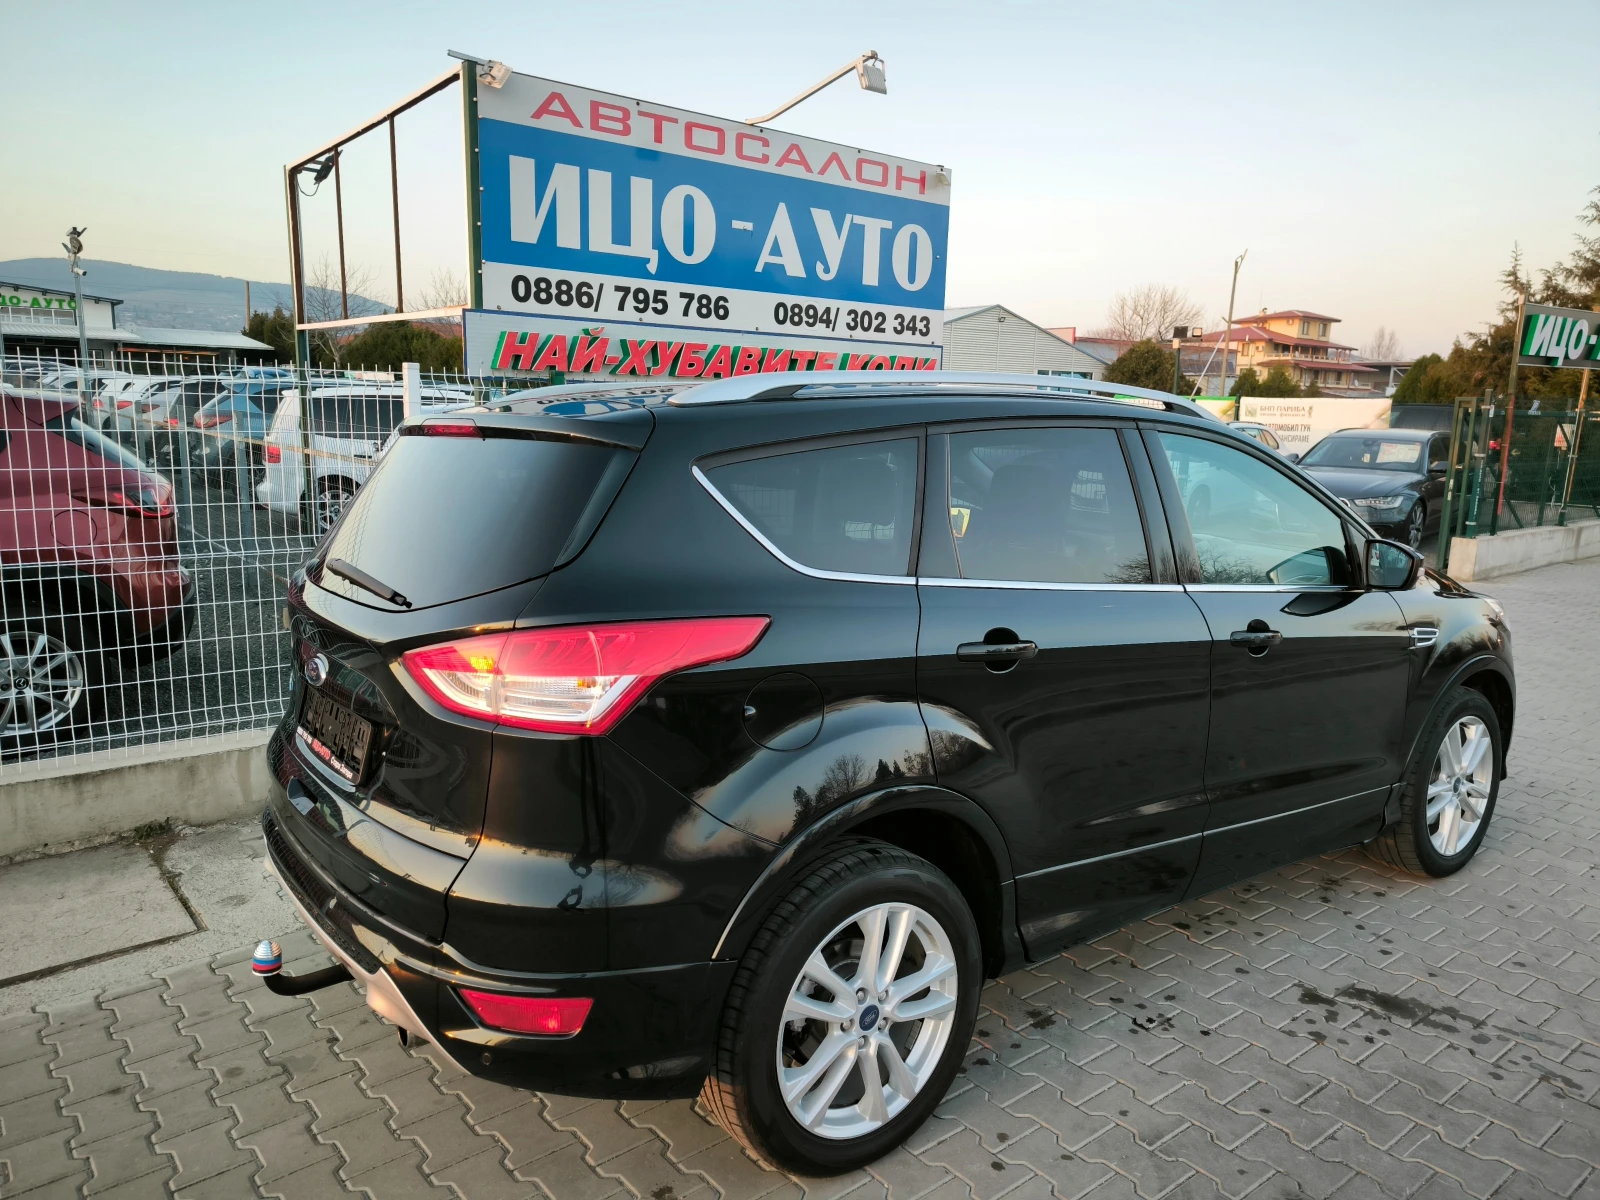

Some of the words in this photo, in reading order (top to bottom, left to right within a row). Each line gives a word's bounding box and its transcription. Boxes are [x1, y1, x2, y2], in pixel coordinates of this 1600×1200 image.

[530, 91, 927, 196] АВТОСАЛОН
[511, 274, 604, 313] 0886/
[613, 285, 669, 316] 795
[679, 292, 730, 320] 786
[774, 301, 840, 332] 0894/
[846, 309, 887, 334] 302
[893, 313, 931, 337] 343
[495, 326, 838, 379] НАЙ-ХУБАВИТЕ
[1526, 313, 1600, 366] ИЦО-
[1266, 423, 1299, 431] ВТОМОБИЛ
[1300, 424, 1311, 432] ТУК
